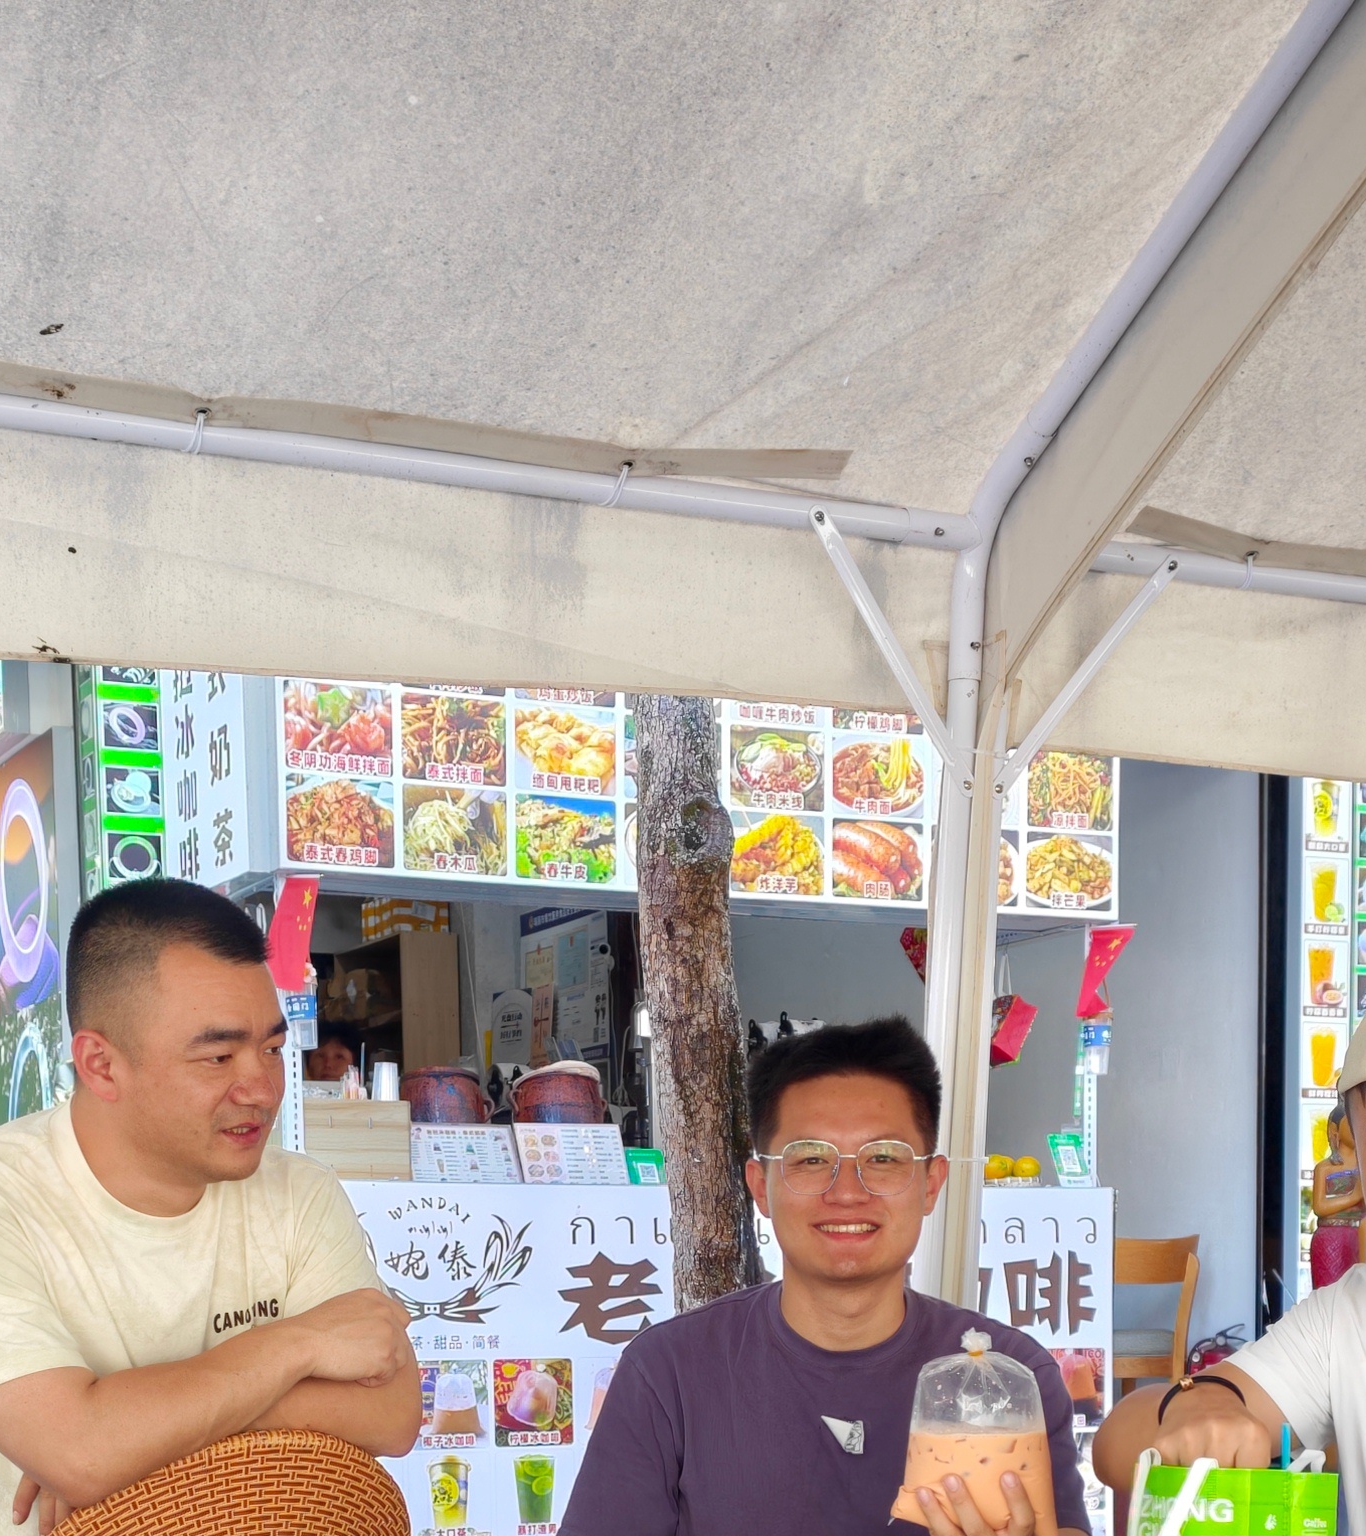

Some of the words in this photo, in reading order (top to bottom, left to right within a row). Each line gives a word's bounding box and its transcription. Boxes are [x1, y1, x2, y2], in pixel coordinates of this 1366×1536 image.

[288, 751, 390, 775] 冬阴功海鲜拌面
[427, 764, 483, 783] 泰式拌面
[752, 793, 803, 809] 牛肉米线
[854, 800, 892, 815] 牛肉面
[758, 877, 797, 892] 炸洋芋
[865, 883, 891, 898] 肉肠
[1052, 894, 1085, 907] 拌芒果
[388, 1196, 471, 1224] WANDAI
[423, 1434, 475, 1447] 椰子冰咖啡
[509, 1432, 561, 1445] 柠檬冰咖啡
